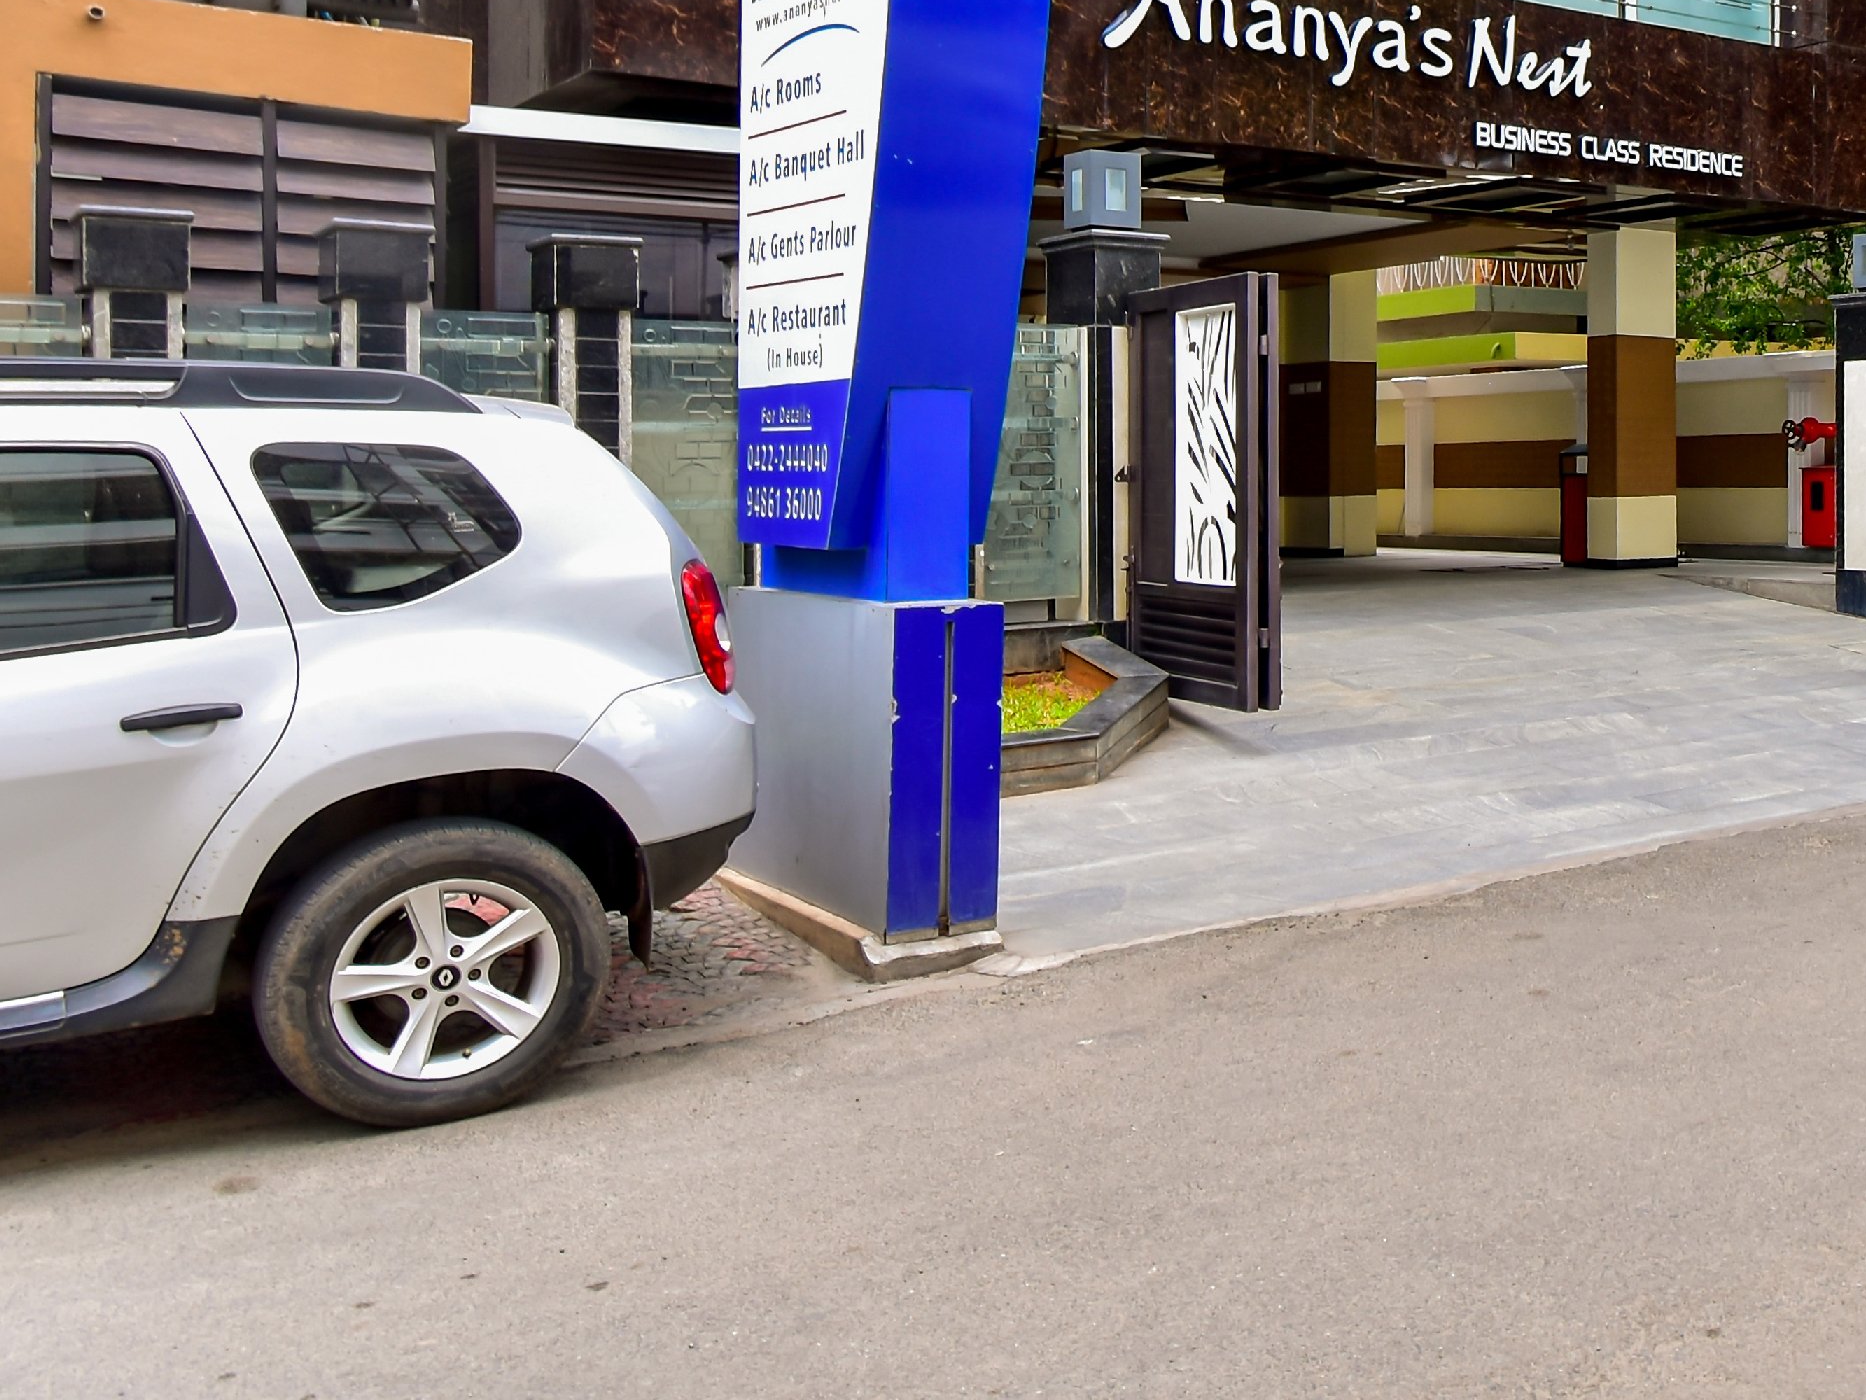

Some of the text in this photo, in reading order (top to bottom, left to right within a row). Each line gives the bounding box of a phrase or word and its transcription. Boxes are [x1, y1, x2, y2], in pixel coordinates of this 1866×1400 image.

[1468, 16, 1593, 97] Nest
[750, 73, 822, 114] A/c Rooms
[749, 129, 864, 187] A/c Banquet Hall
[1475, 121, 1743, 178] BUSINESS CLASS RESIDENCE
[748, 220, 856, 265] A/c Gents Parlour
[748, 299, 846, 337] A/c Restaurant
[767, 343, 823, 371] (In House)
[761, 406, 776, 424] For
[747, 444, 828, 472] 0422-2444040
[784, 487, 822, 521] 36000
